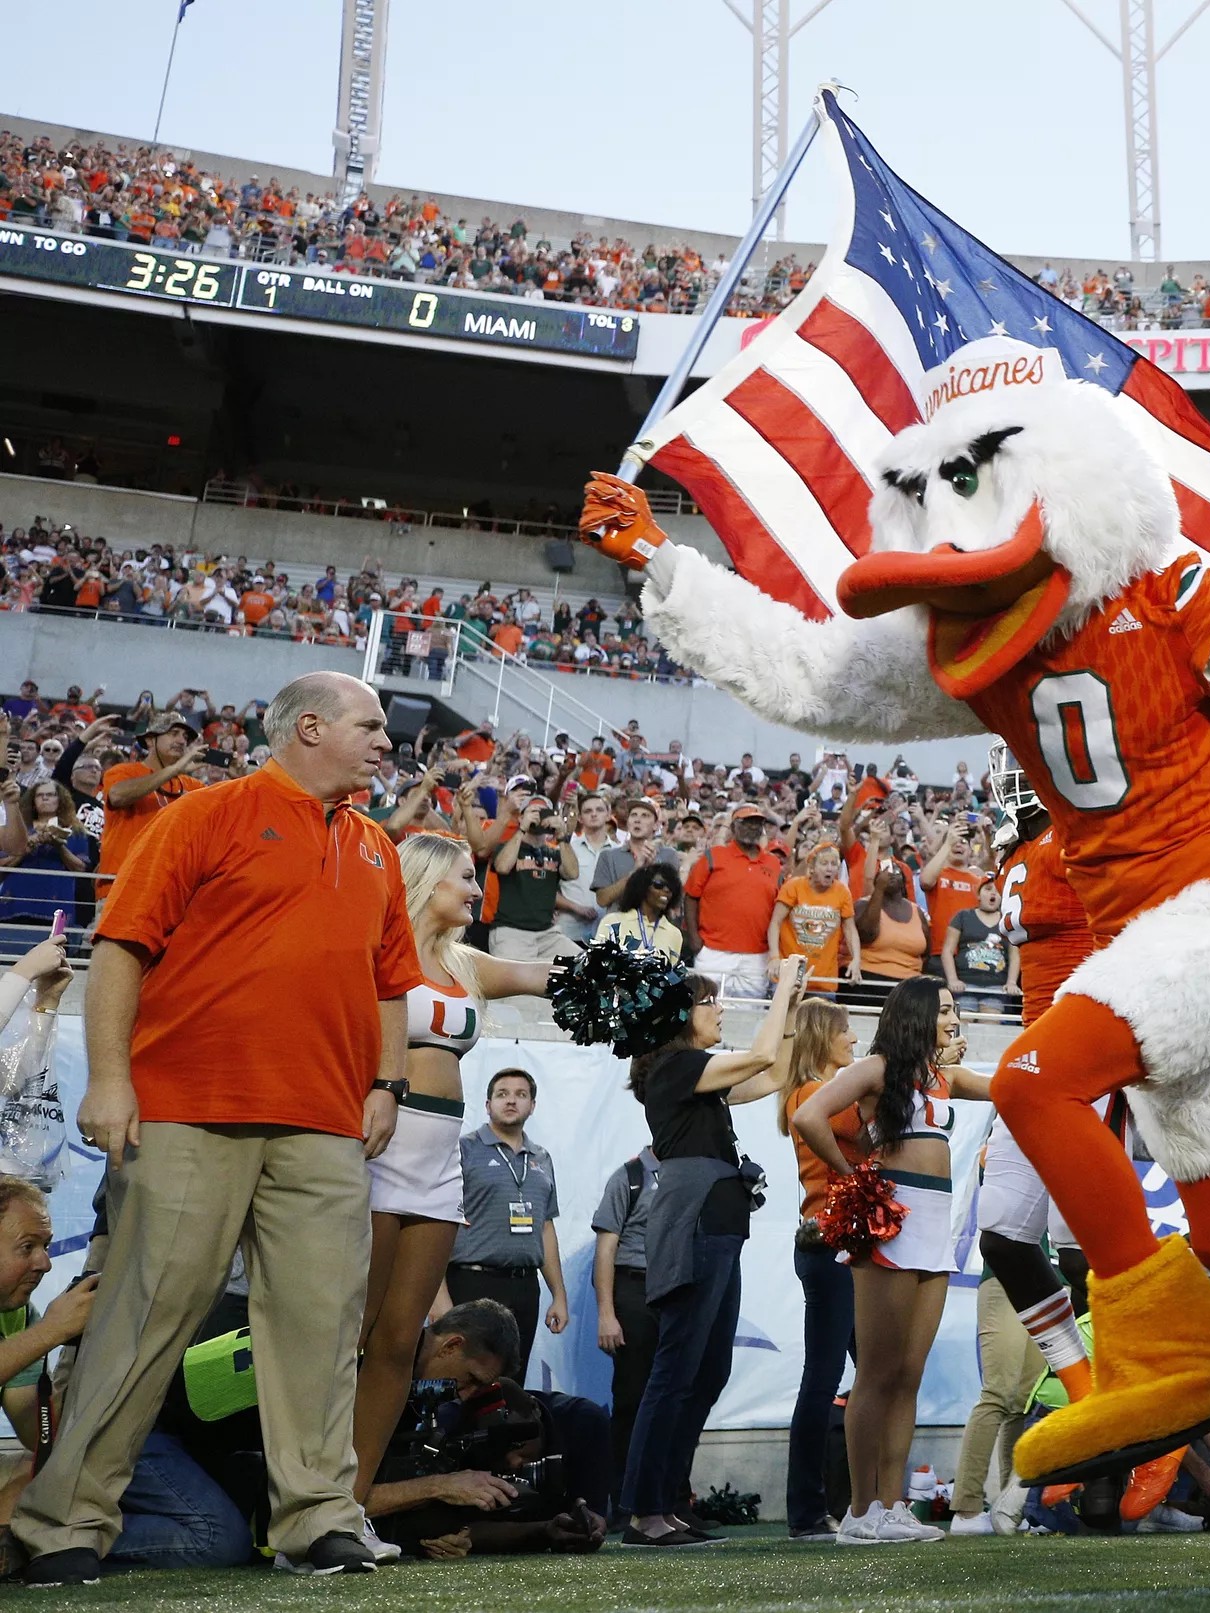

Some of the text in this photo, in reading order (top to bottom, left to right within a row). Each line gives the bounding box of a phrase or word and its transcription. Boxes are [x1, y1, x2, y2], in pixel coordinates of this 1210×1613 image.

[34, 236, 86, 256] TO GO
[126, 252, 221, 300] 3:26
[257, 271, 291, 287] QTR
[303, 276, 373, 298] BALL ON
[408, 292, 439, 328] 0
[588, 313, 617, 329] TOL
[464, 312, 536, 341] MIAMI
[1108, 621, 1143, 635] adidas
[1030, 670, 1131, 812] 0
[359, 842, 384, 869] U
[428, 999, 477, 1041] U
[1006, 1061, 1041, 1074] adidas
[924, 1100, 955, 1131] U
[40, 1406, 50, 1444] Canon
